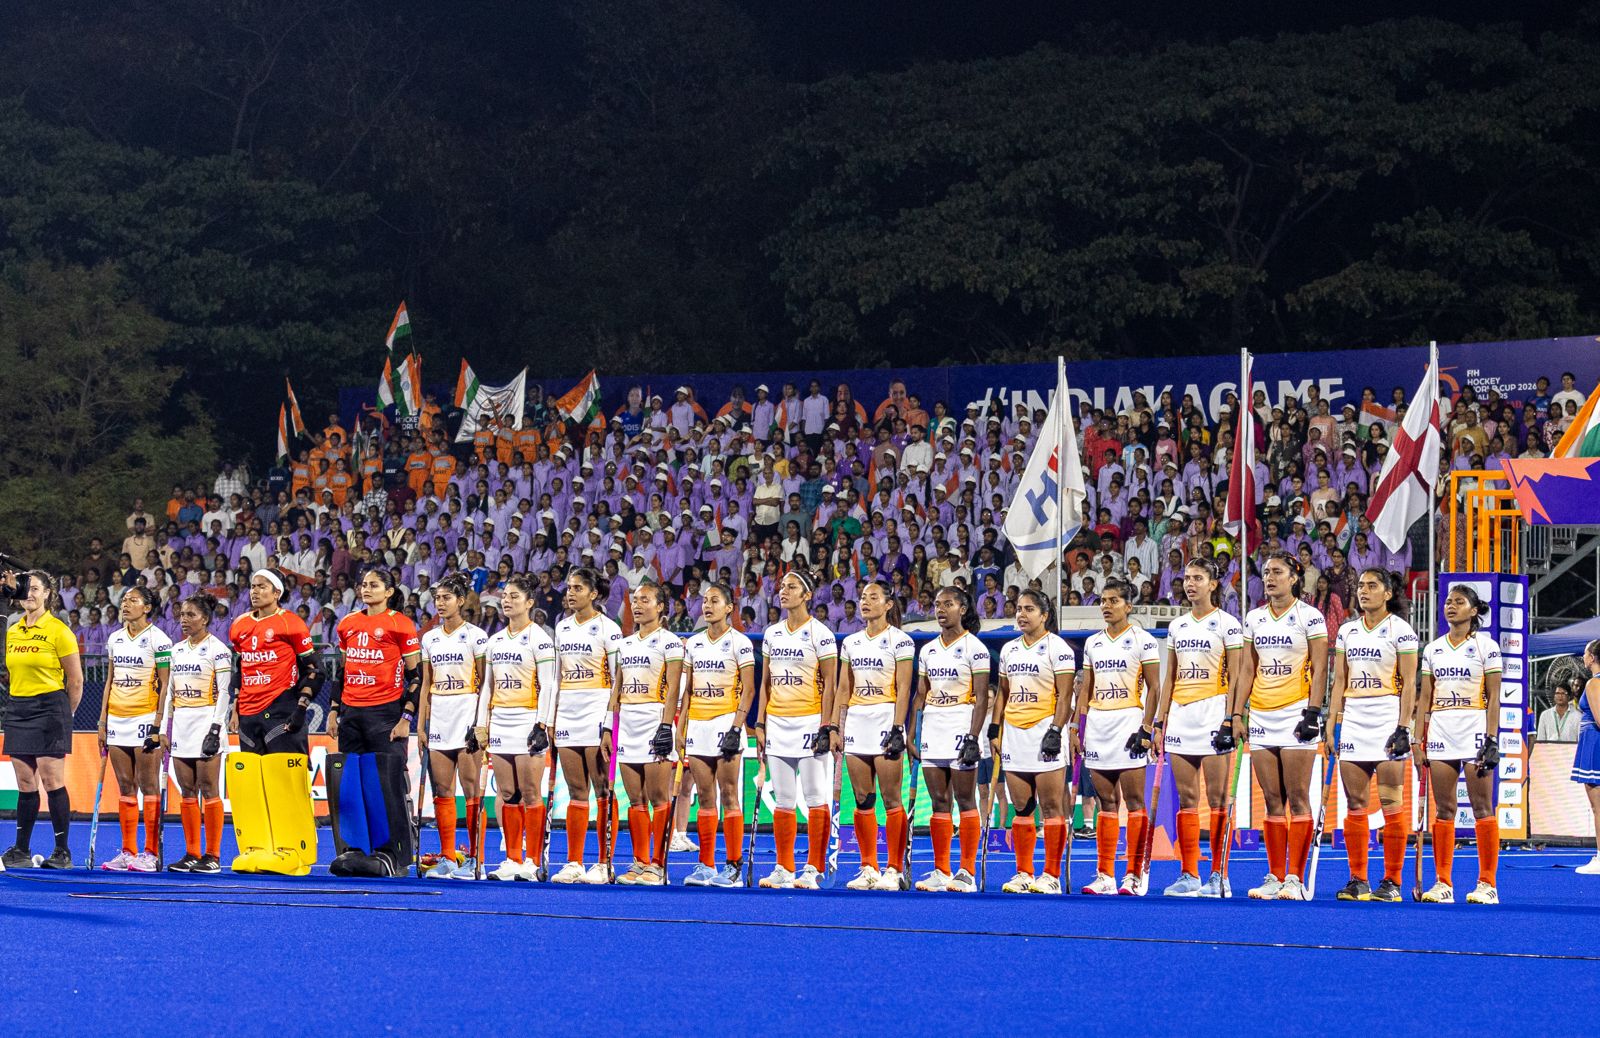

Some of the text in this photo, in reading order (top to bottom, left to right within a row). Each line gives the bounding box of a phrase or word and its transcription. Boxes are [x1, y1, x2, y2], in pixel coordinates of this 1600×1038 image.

[1468, 377, 1500, 385] HOCKEY
[1518, 382, 1536, 390] 2026
[252, 636, 258, 650] 9
[357, 632, 369, 646] 10
[1255, 636, 1292, 645] ODISHA
[560, 643, 592, 652] ODISHA
[1176, 640, 1211, 649] ODISHA
[242, 650, 278, 662] ODISHA
[346, 647, 384, 660] ODISHA
[492, 652, 522, 662] ODISHA
[771, 648, 804, 657] ODISHA
[1348, 648, 1382, 658] ODISHA
[113, 656, 144, 664] ODISHA
[432, 653, 464, 663] ODISHA
[621, 656, 650, 665] ODISHA
[851, 658, 884, 667] ODISHA
[695, 660, 725, 669] ODISHA
[1008, 663, 1040, 673] ODISHA
[1095, 660, 1127, 669] ODISHA
[928, 668, 958, 677] ODISHA
[1435, 668, 1471, 677] ODISHA
[496, 673, 522, 689] ndia
[1350, 671, 1382, 689] ndia
[694, 682, 724, 698] ndia
[287, 758, 302, 768] BK
